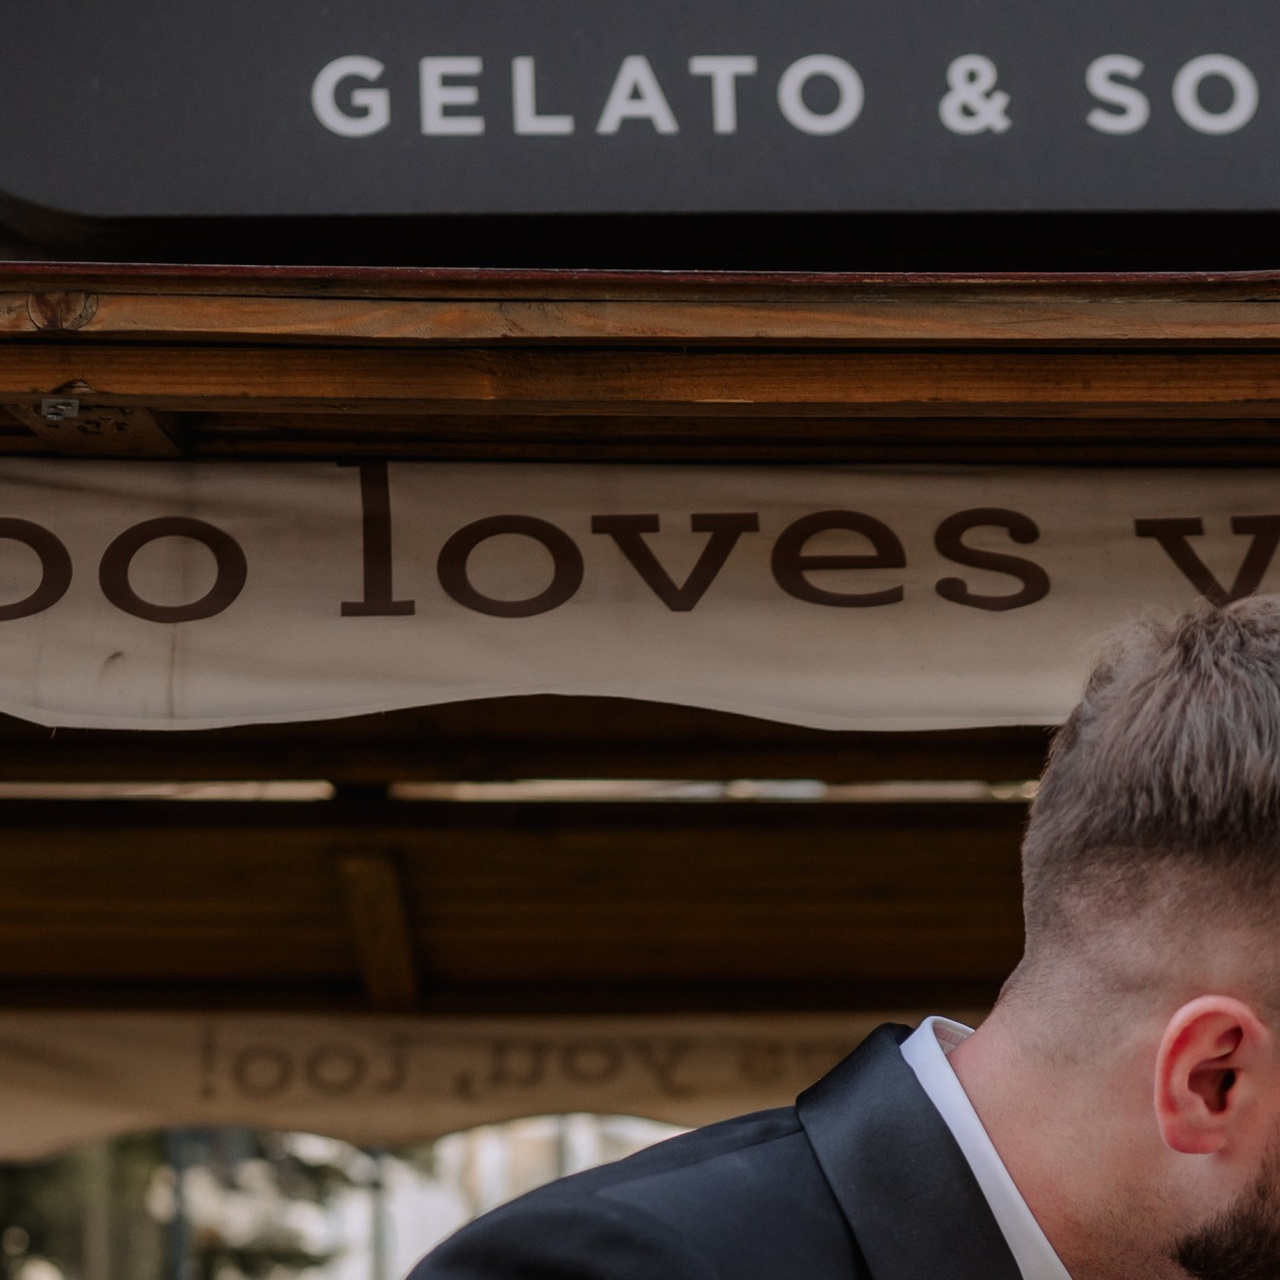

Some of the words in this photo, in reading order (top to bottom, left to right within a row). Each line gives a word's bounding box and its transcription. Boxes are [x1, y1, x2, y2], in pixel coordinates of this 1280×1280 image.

[310, 54, 865, 138] GELATO
[938, 54, 1013, 135] &
[336, 461, 1052, 618] loves
